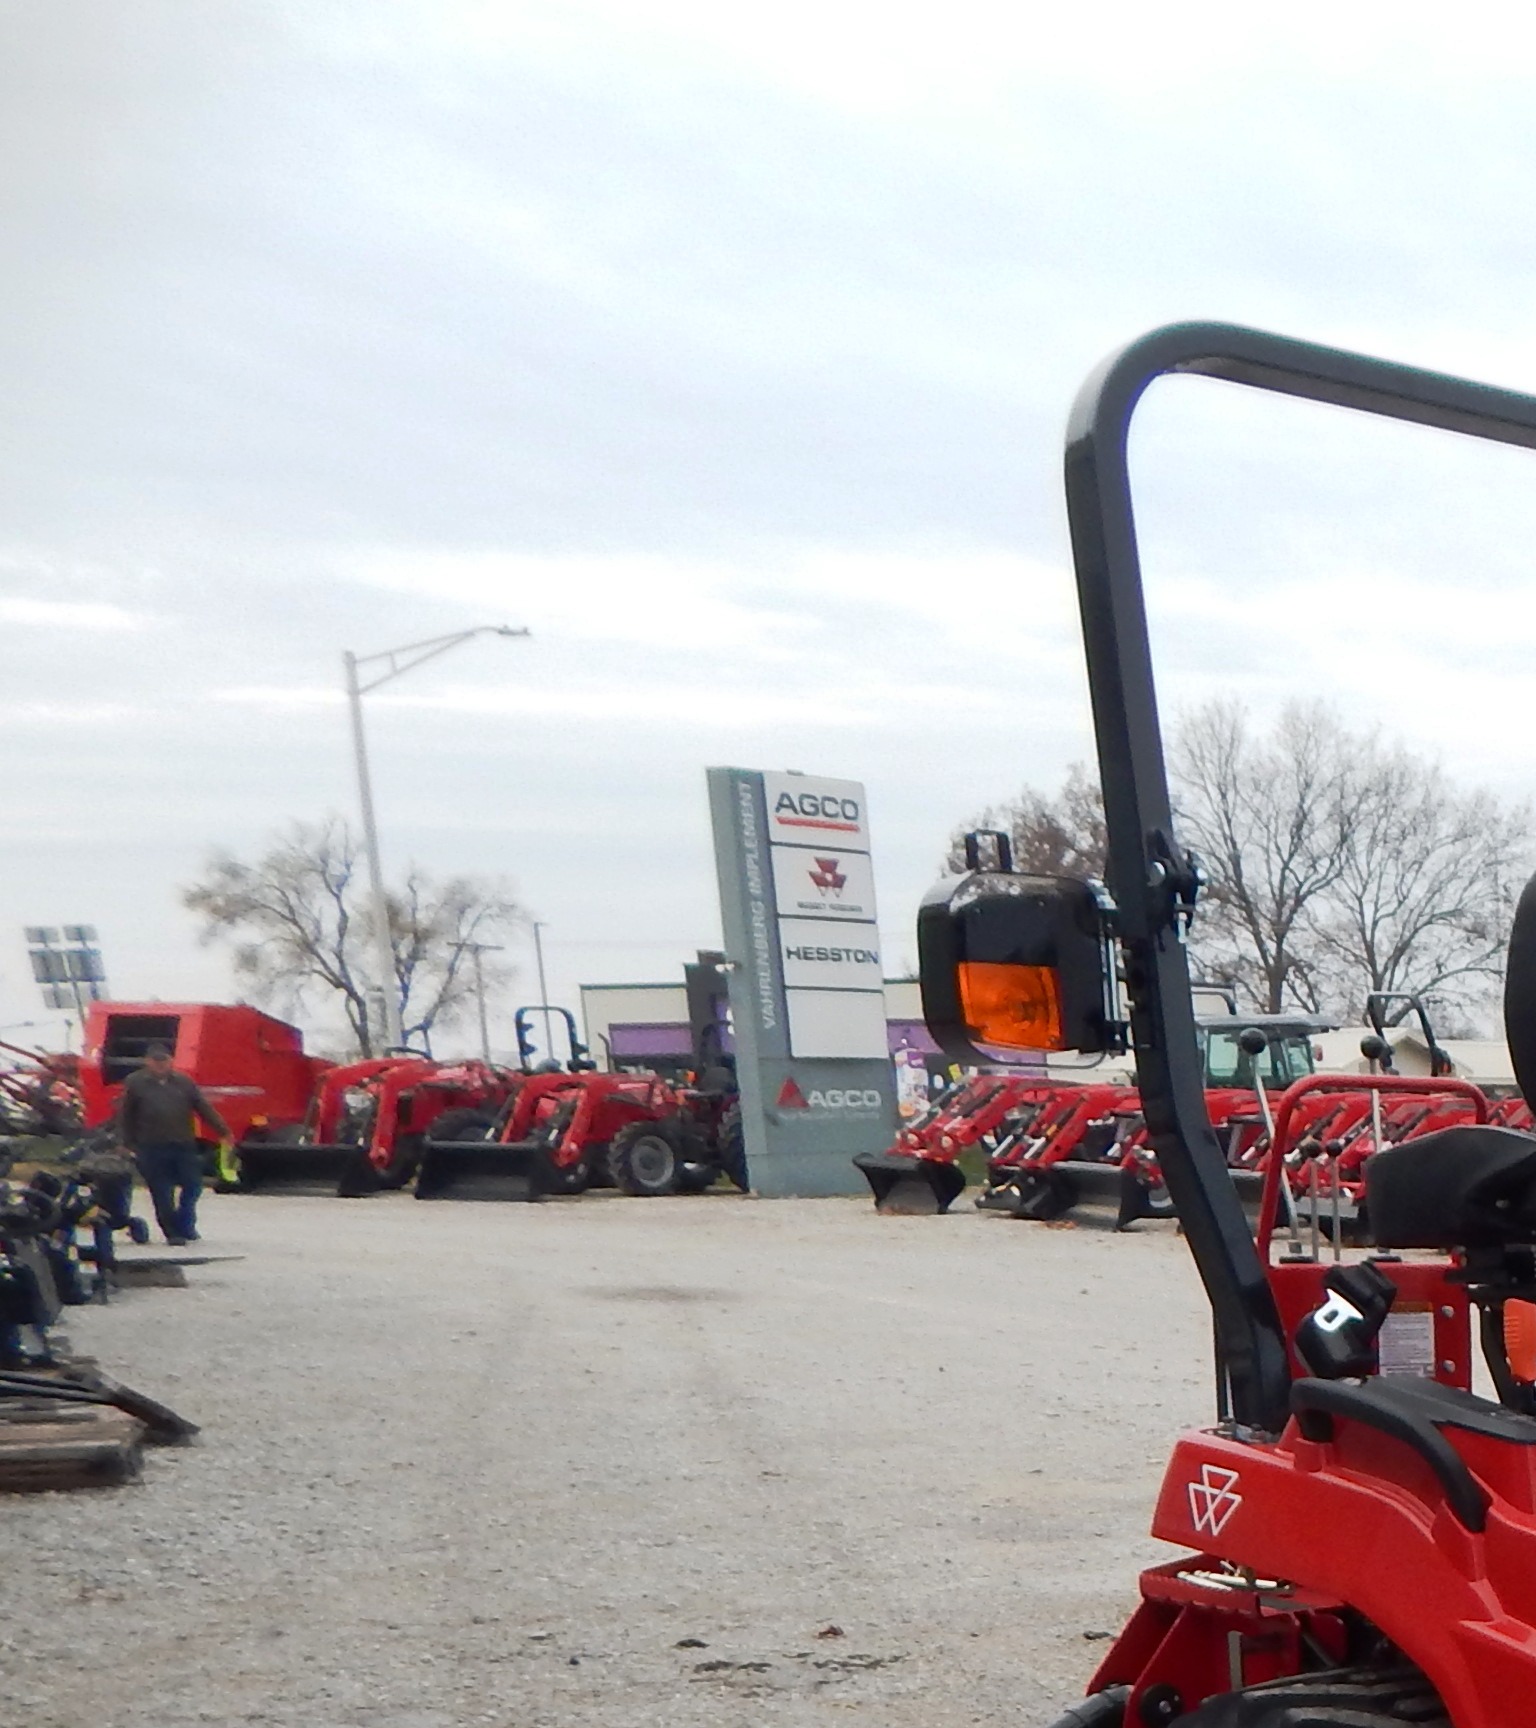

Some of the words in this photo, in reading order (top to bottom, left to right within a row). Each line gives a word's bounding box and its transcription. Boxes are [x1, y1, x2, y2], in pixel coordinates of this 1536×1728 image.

[775, 792, 859, 820] AGCO
[738, 783, 763, 895] IMPLEMENT
[786, 946, 878, 964] HESSTON
[808, 1089, 882, 1108] AGCO
